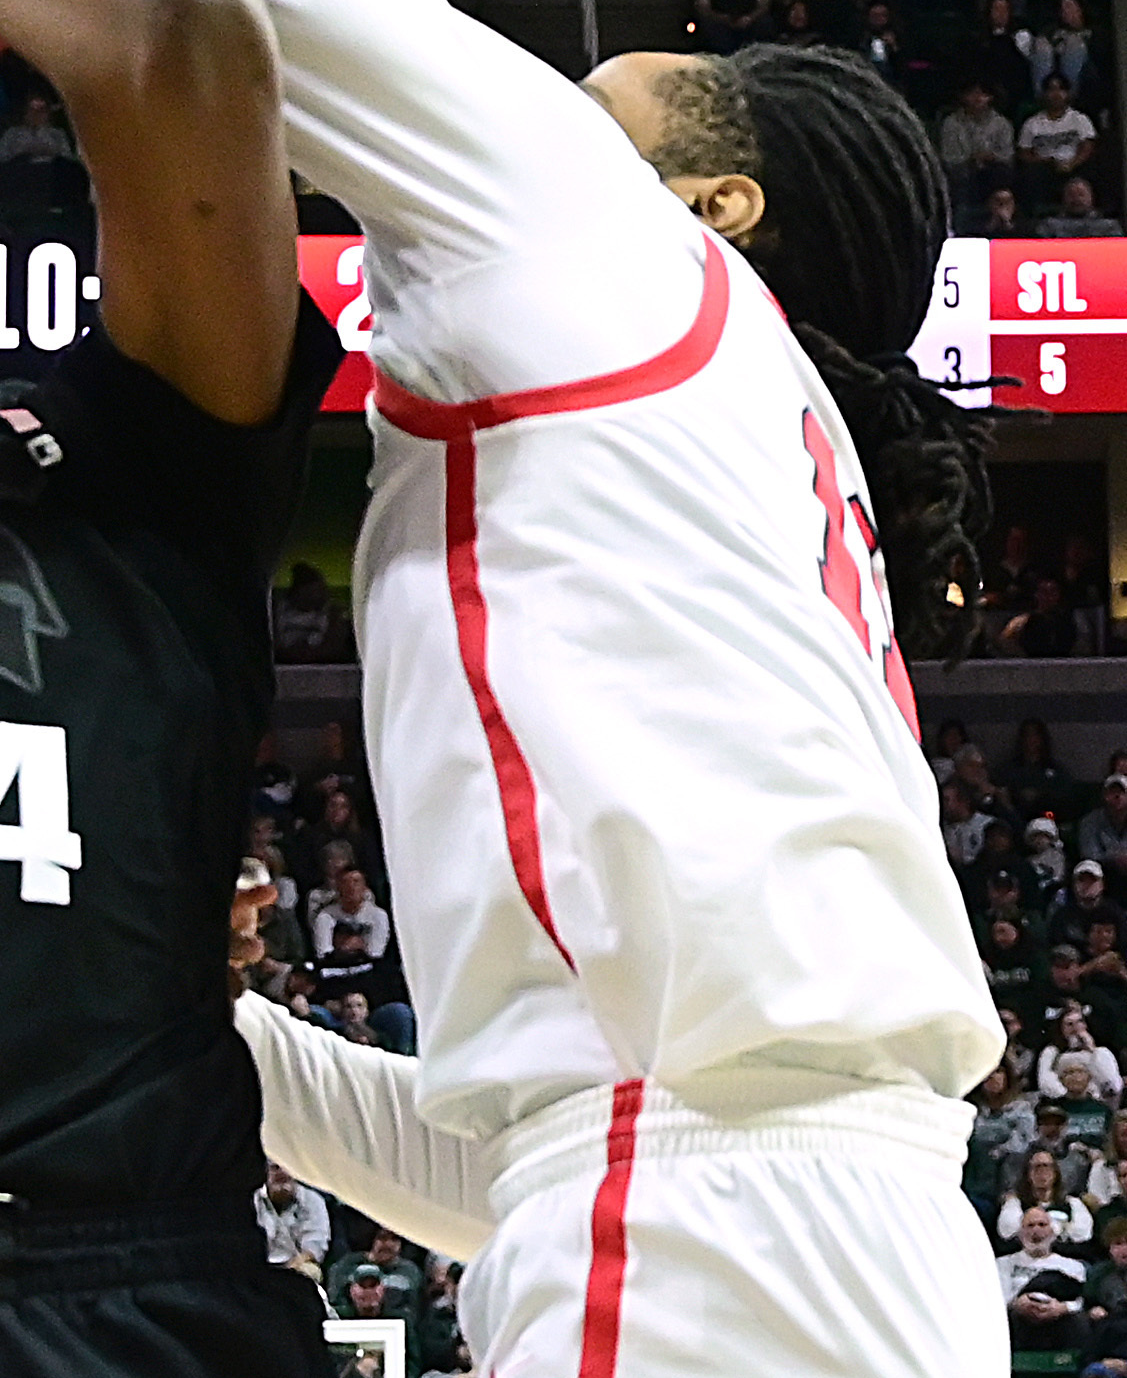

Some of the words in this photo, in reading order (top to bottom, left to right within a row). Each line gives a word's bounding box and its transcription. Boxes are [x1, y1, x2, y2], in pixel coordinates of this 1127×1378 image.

[943, 266, 960, 308] 5
[1017, 261, 1088, 313] STL
[943, 346, 962, 384] 3
[1039, 342, 1067, 395] 5
